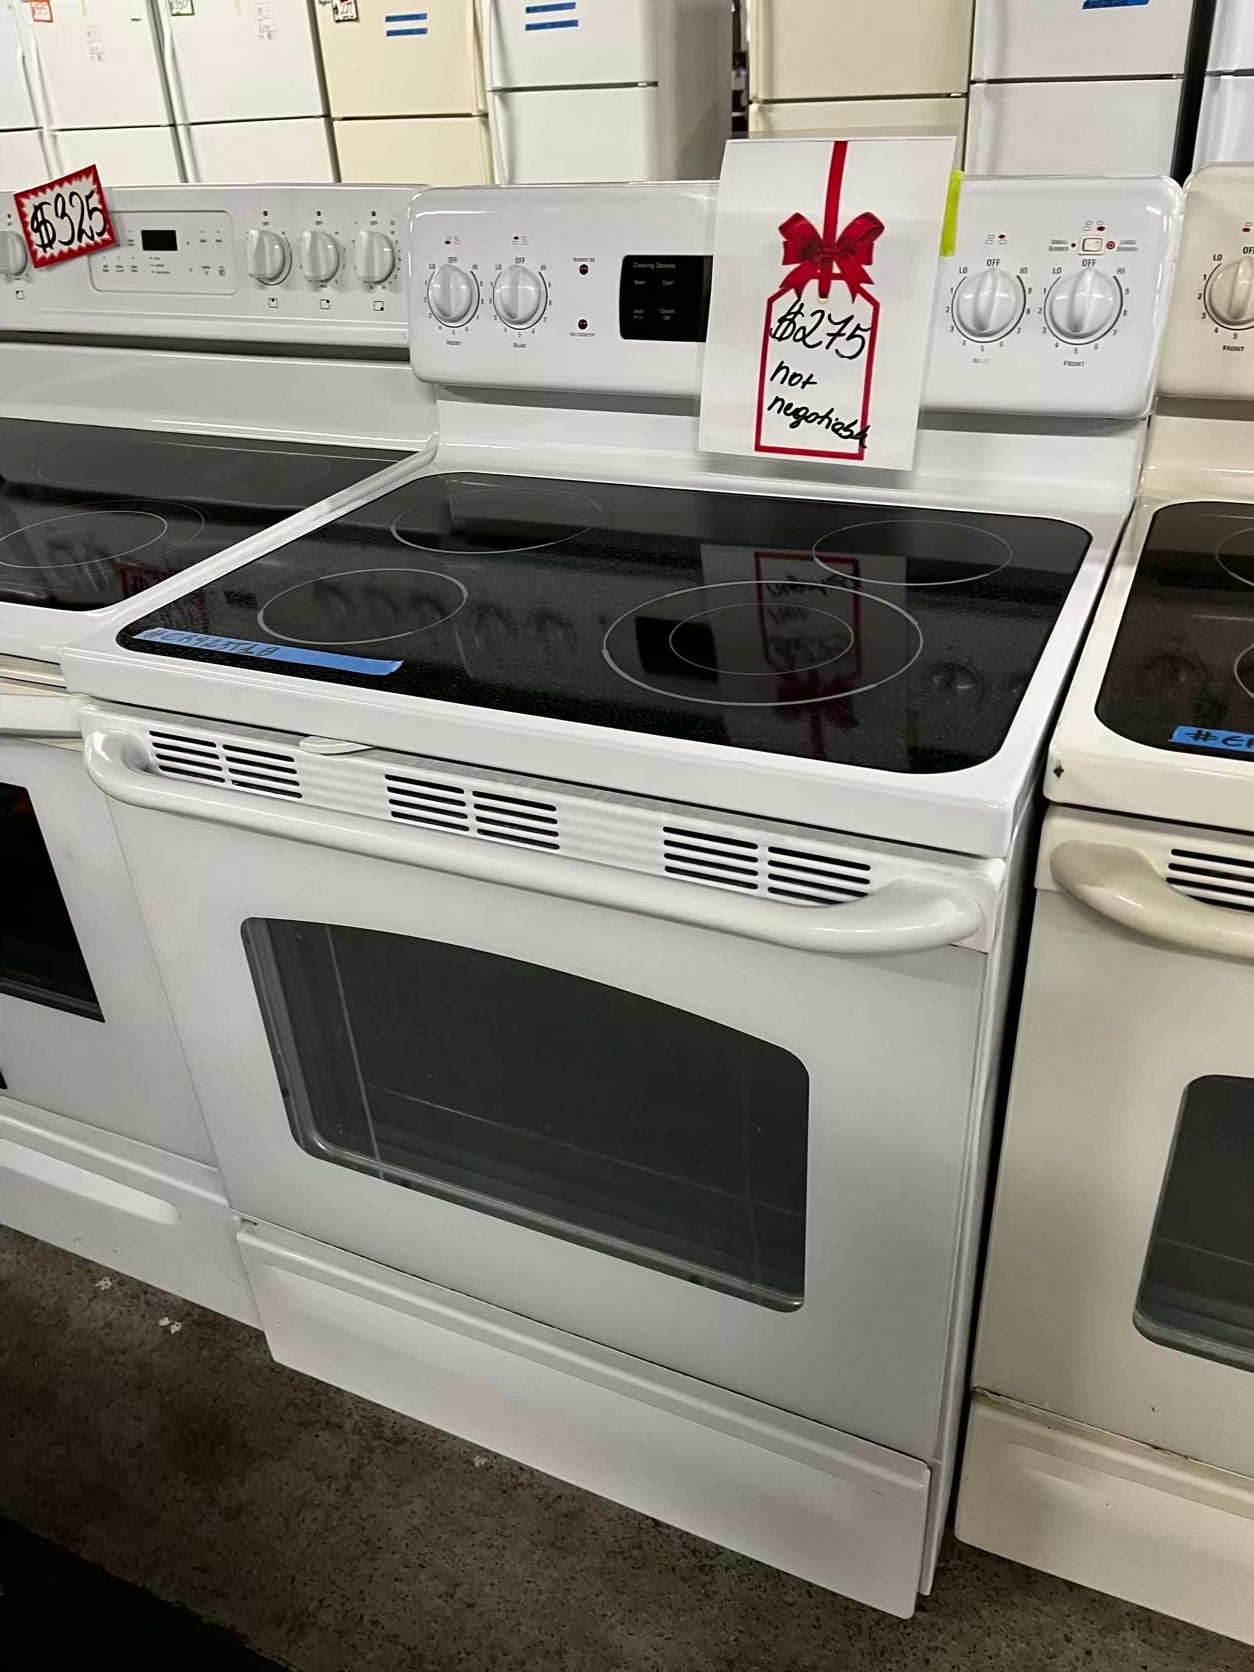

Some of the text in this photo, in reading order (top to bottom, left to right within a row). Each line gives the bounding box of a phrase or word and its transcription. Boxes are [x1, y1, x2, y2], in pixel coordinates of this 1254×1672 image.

[30, 188, 107, 254] $325
[1213, 253, 1223, 261] LO
[986, 258, 1001, 267] OFF
[1081, 259, 1097, 267] OFF
[1052, 266, 1062, 275] LO
[769, 298, 871, 360] $275
[769, 360, 818, 389] not
